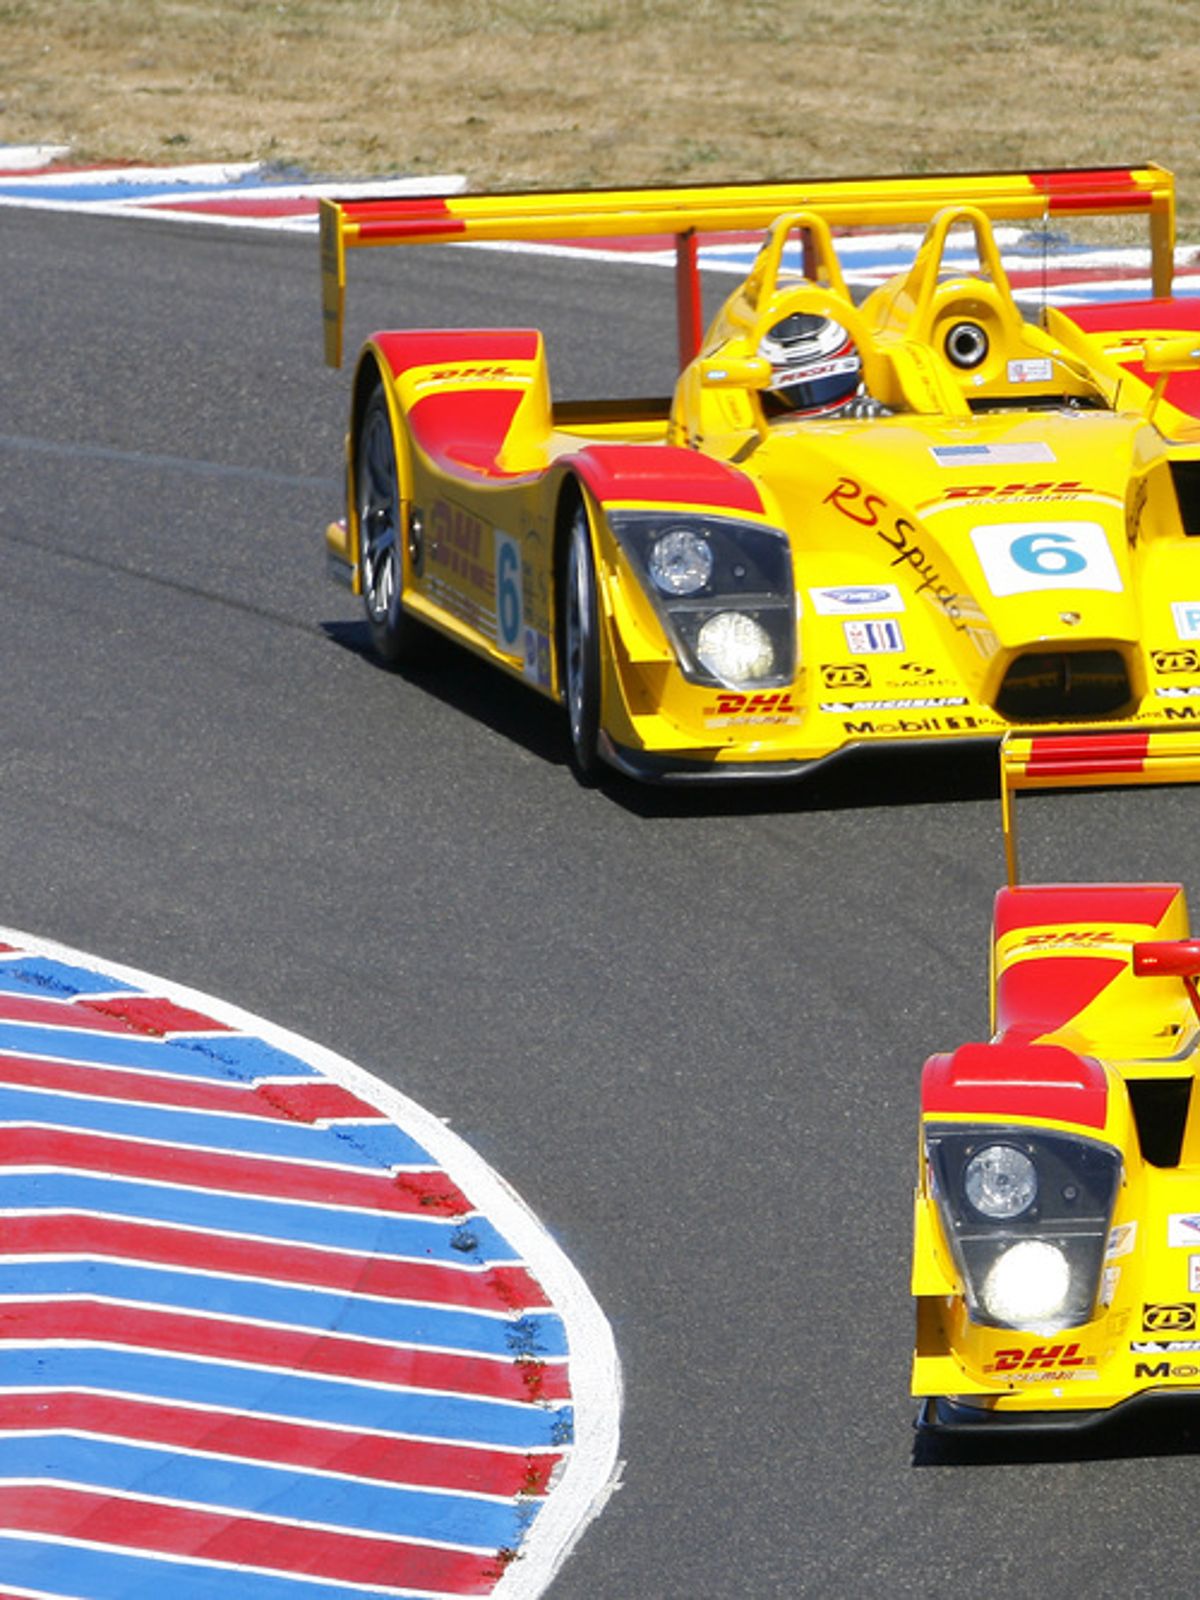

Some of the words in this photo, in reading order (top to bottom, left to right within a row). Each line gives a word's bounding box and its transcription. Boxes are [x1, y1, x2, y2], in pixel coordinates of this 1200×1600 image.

[944, 481, 1094, 500] DHL
[822, 477, 887, 527] RS
[877, 518, 967, 632] Spyder
[1009, 532, 1088, 575] 6
[499, 542, 519, 643] 6
[716, 693, 795, 714] DHL
[843, 718, 941, 733] Mobil
[1024, 932, 1116, 946] DHL
[994, 1343, 1085, 1371] DHL
